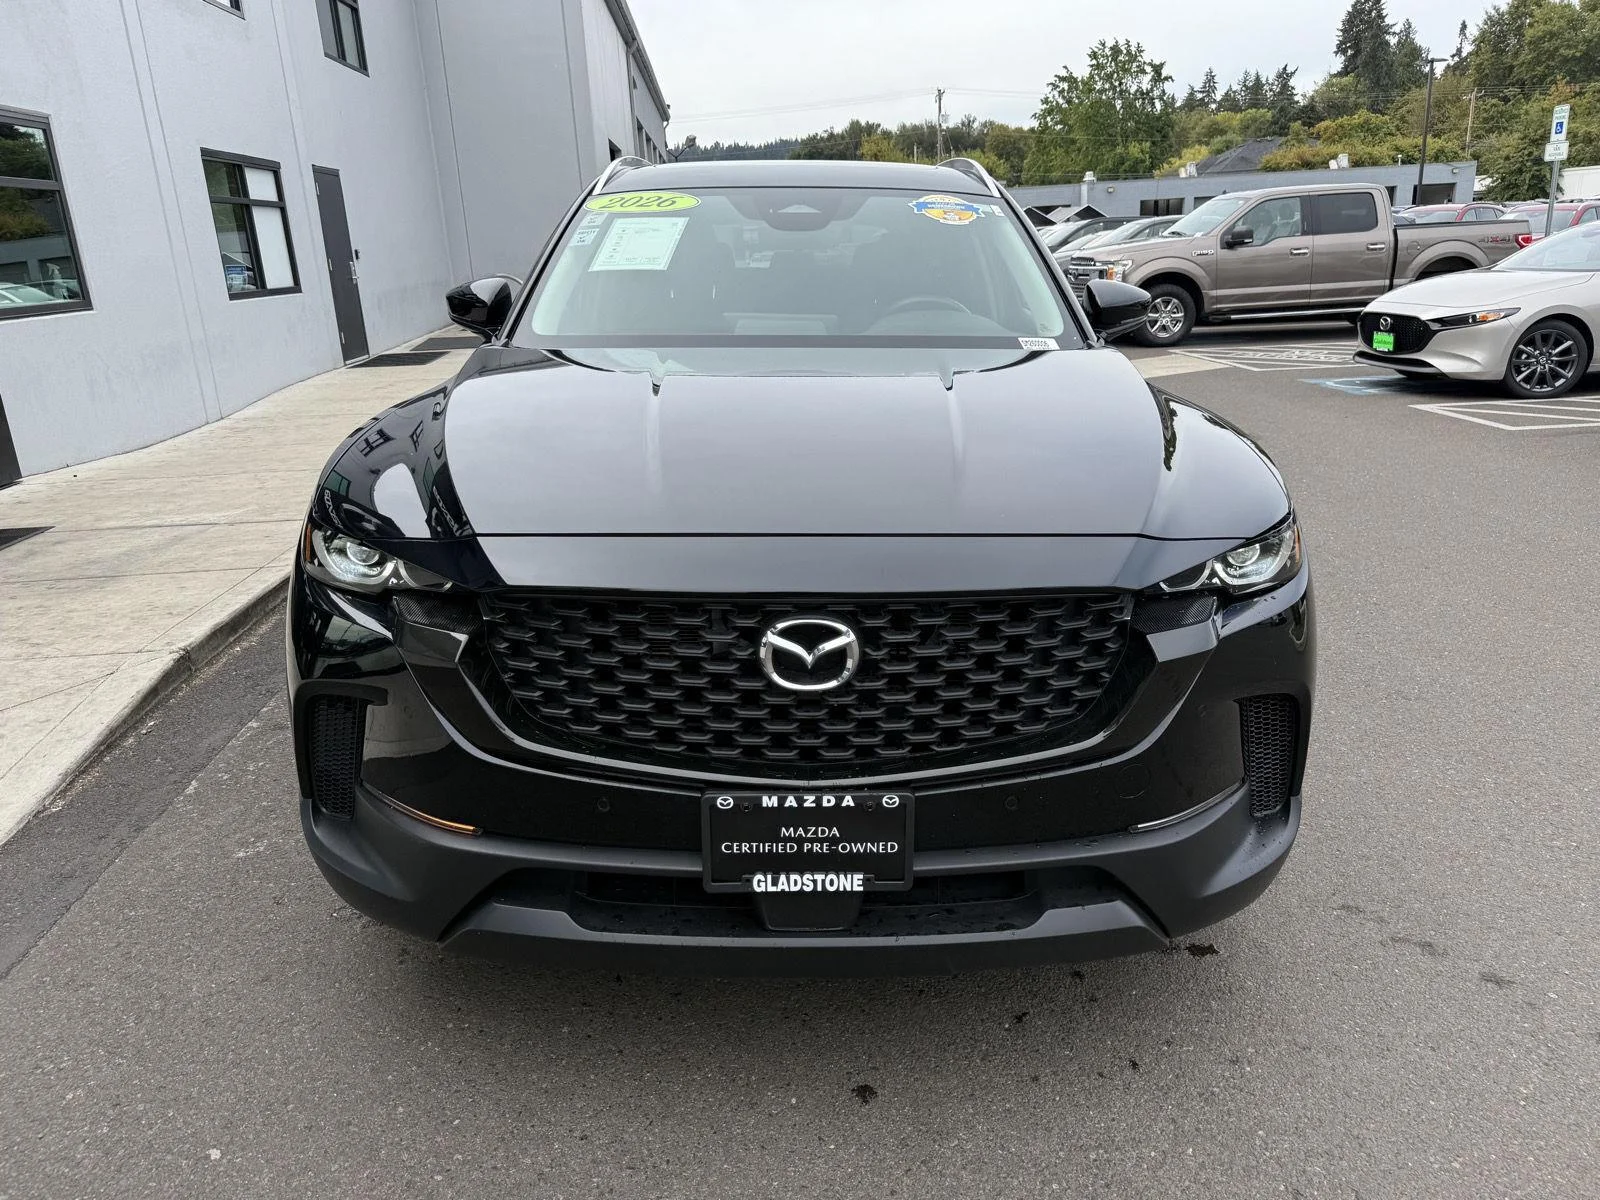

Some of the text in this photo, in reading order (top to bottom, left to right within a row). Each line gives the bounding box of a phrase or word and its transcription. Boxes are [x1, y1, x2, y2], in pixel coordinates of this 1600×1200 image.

[599, 195, 684, 209] 2026
[762, 795, 855, 808] MAZDA
[780, 826, 840, 838] MAZDA
[721, 842, 899, 853] CERTIFIED PRE-OWNED
[752, 874, 864, 892] GLADSTONE
